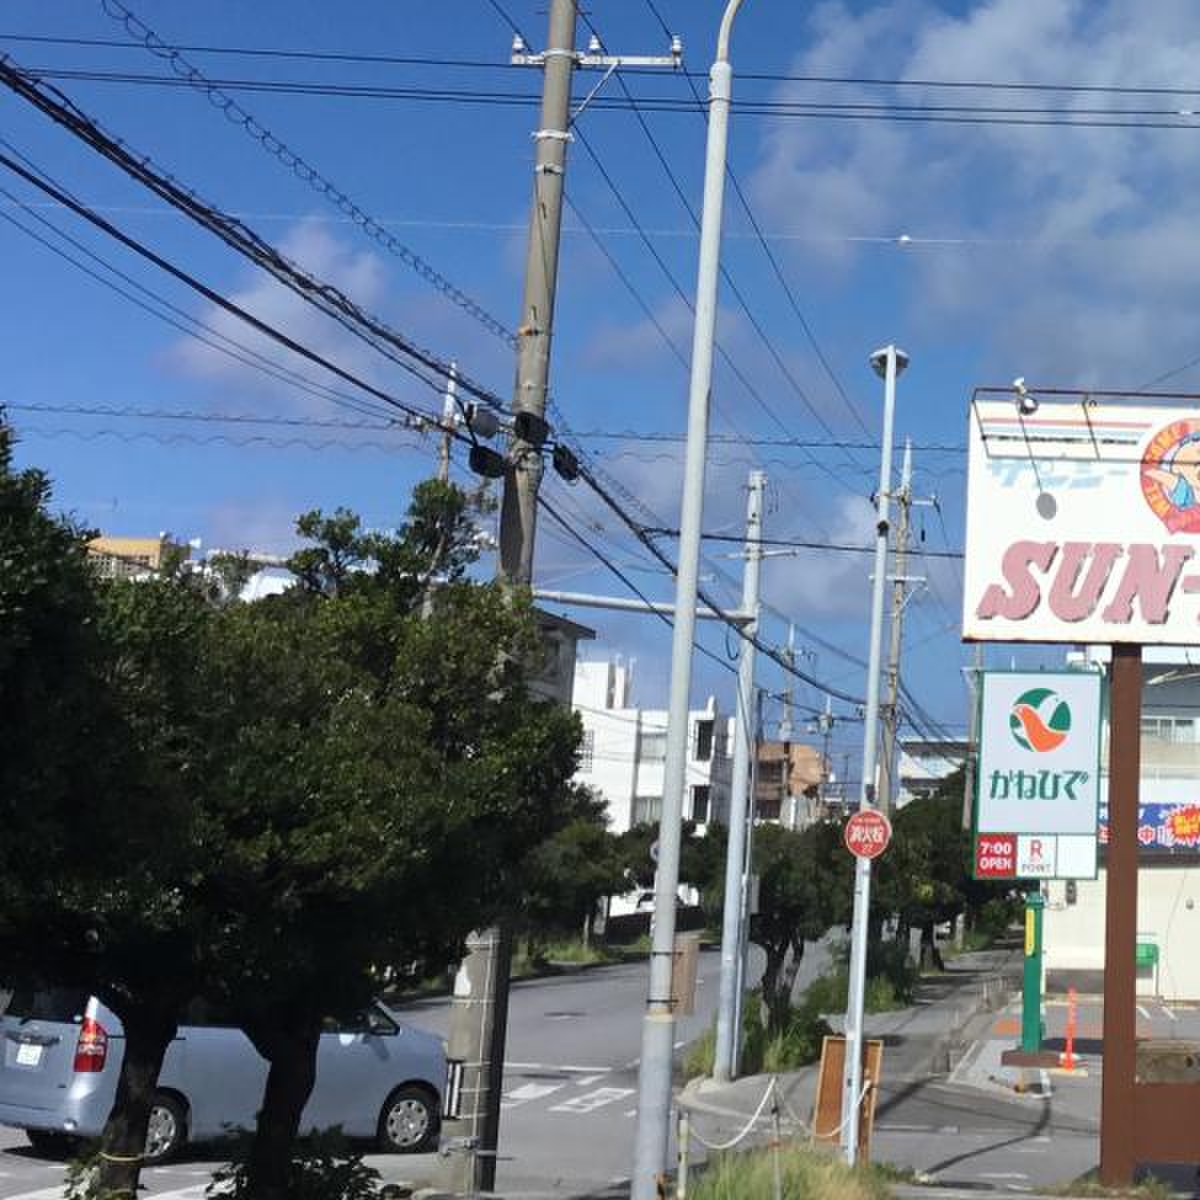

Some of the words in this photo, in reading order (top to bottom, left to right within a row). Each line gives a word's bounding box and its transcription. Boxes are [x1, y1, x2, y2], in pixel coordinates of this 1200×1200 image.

[989, 769, 1089, 801] かねひで
[980, 841, 1012, 855] 7:00
[980, 857, 1013, 870] OPEN
